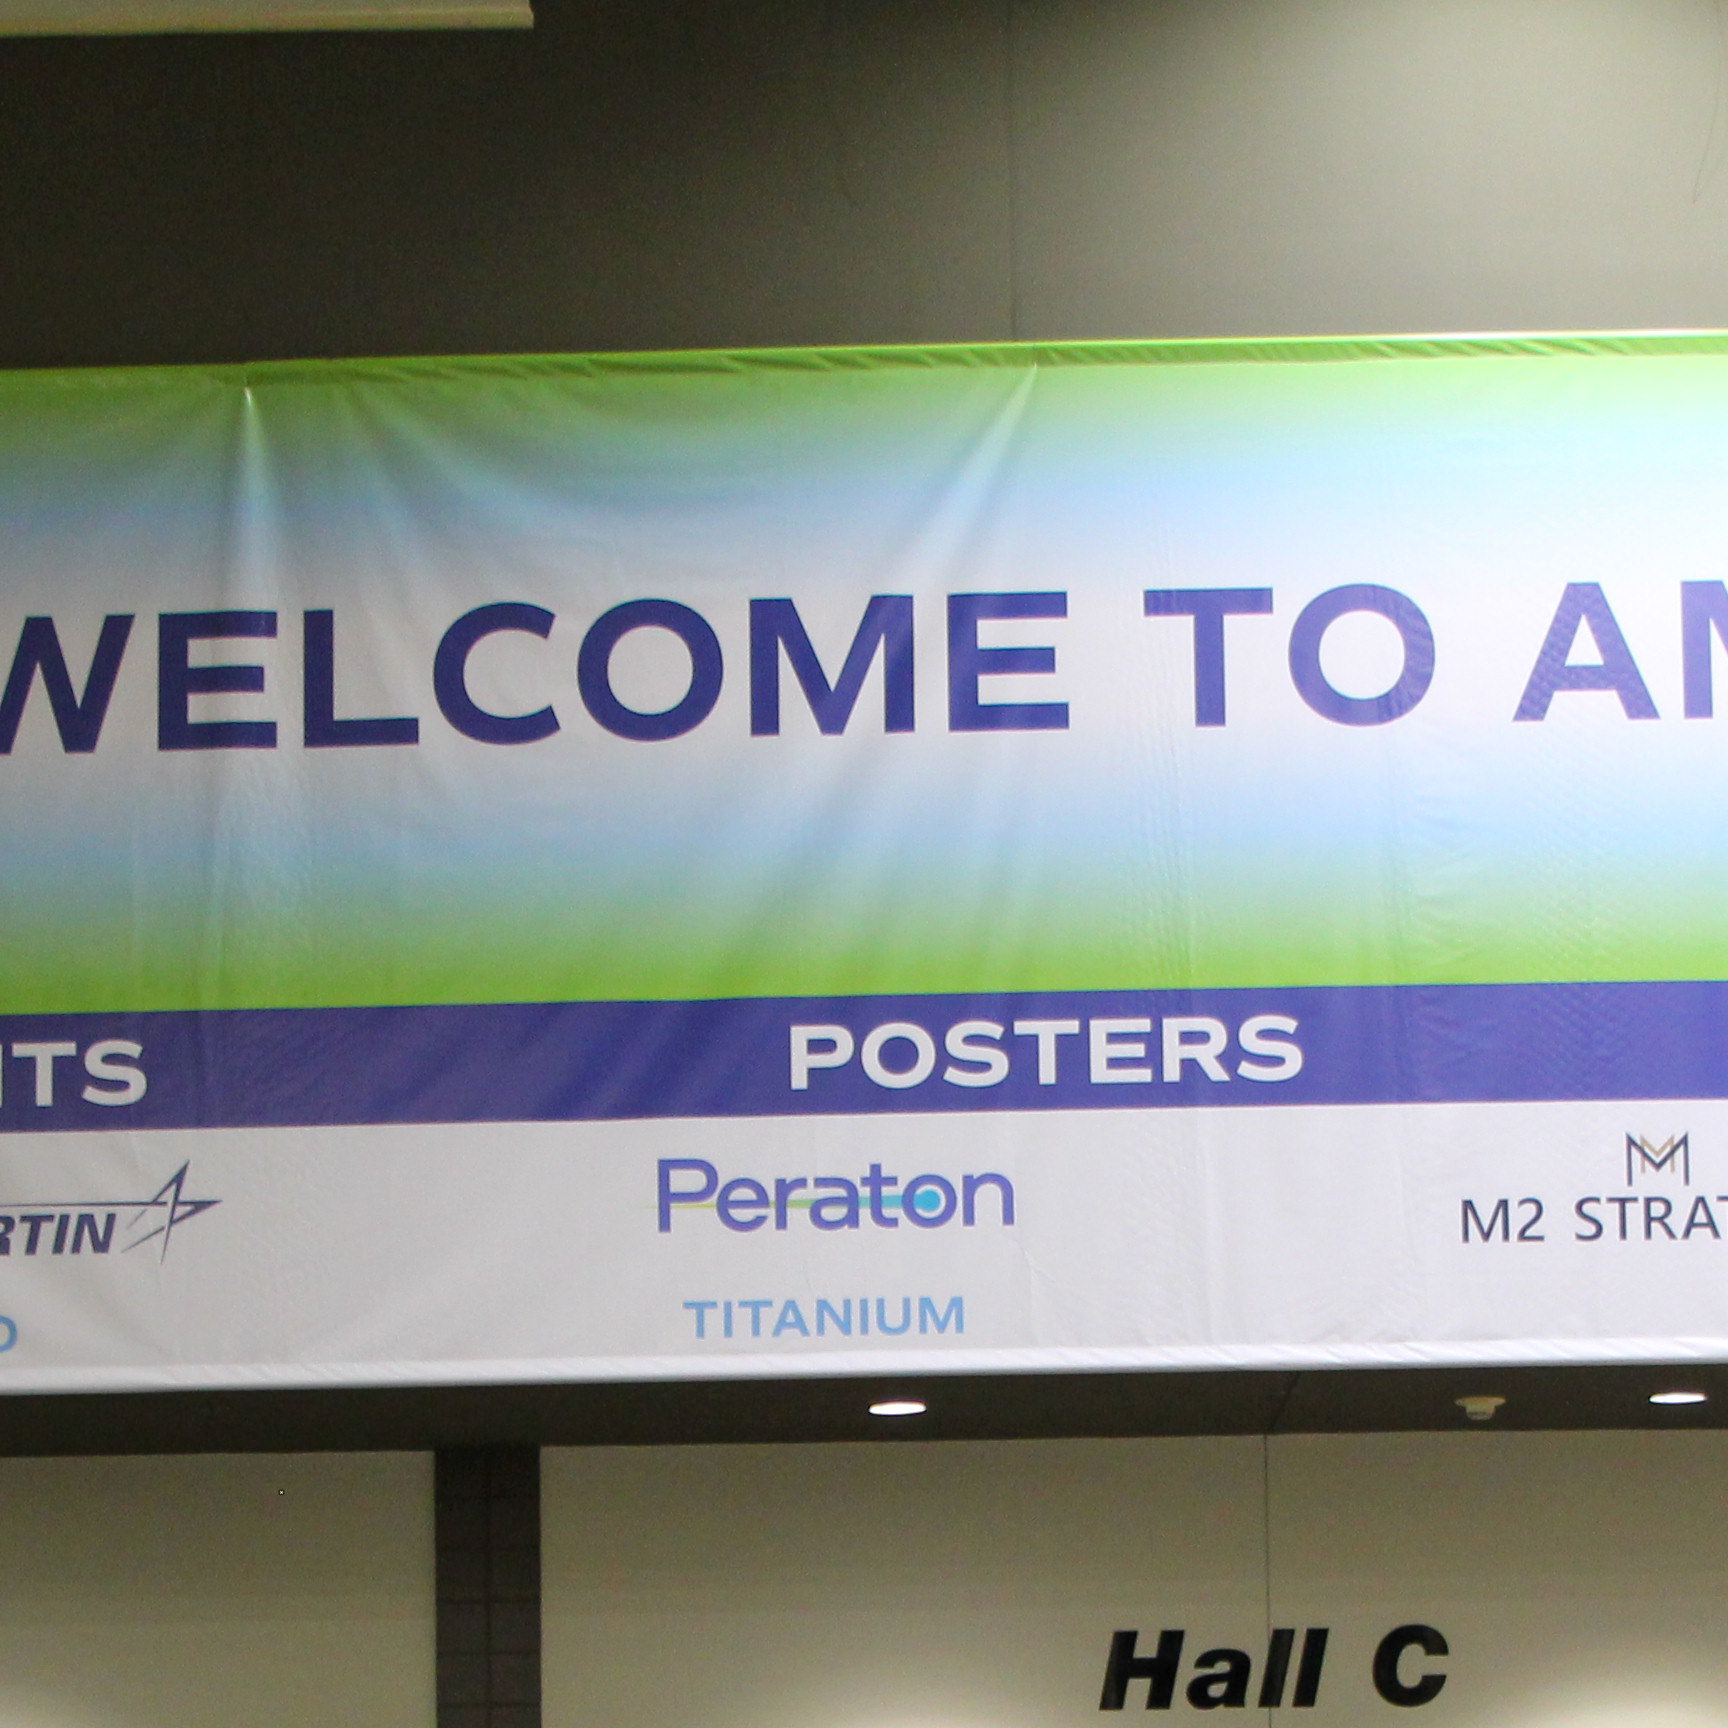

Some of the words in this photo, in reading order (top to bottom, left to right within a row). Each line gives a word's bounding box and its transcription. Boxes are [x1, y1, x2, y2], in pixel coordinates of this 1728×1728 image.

[1143, 583, 1435, 726] TO
[791, 1014, 1303, 1088] POSTERS
[658, 1158, 1014, 1232] Peraton
[1462, 1197, 1544, 1242] M2
[683, 1296, 964, 1338] TITANIUM
[1100, 1628, 1329, 1710] Hall
[1373, 1624, 1449, 1707] C
